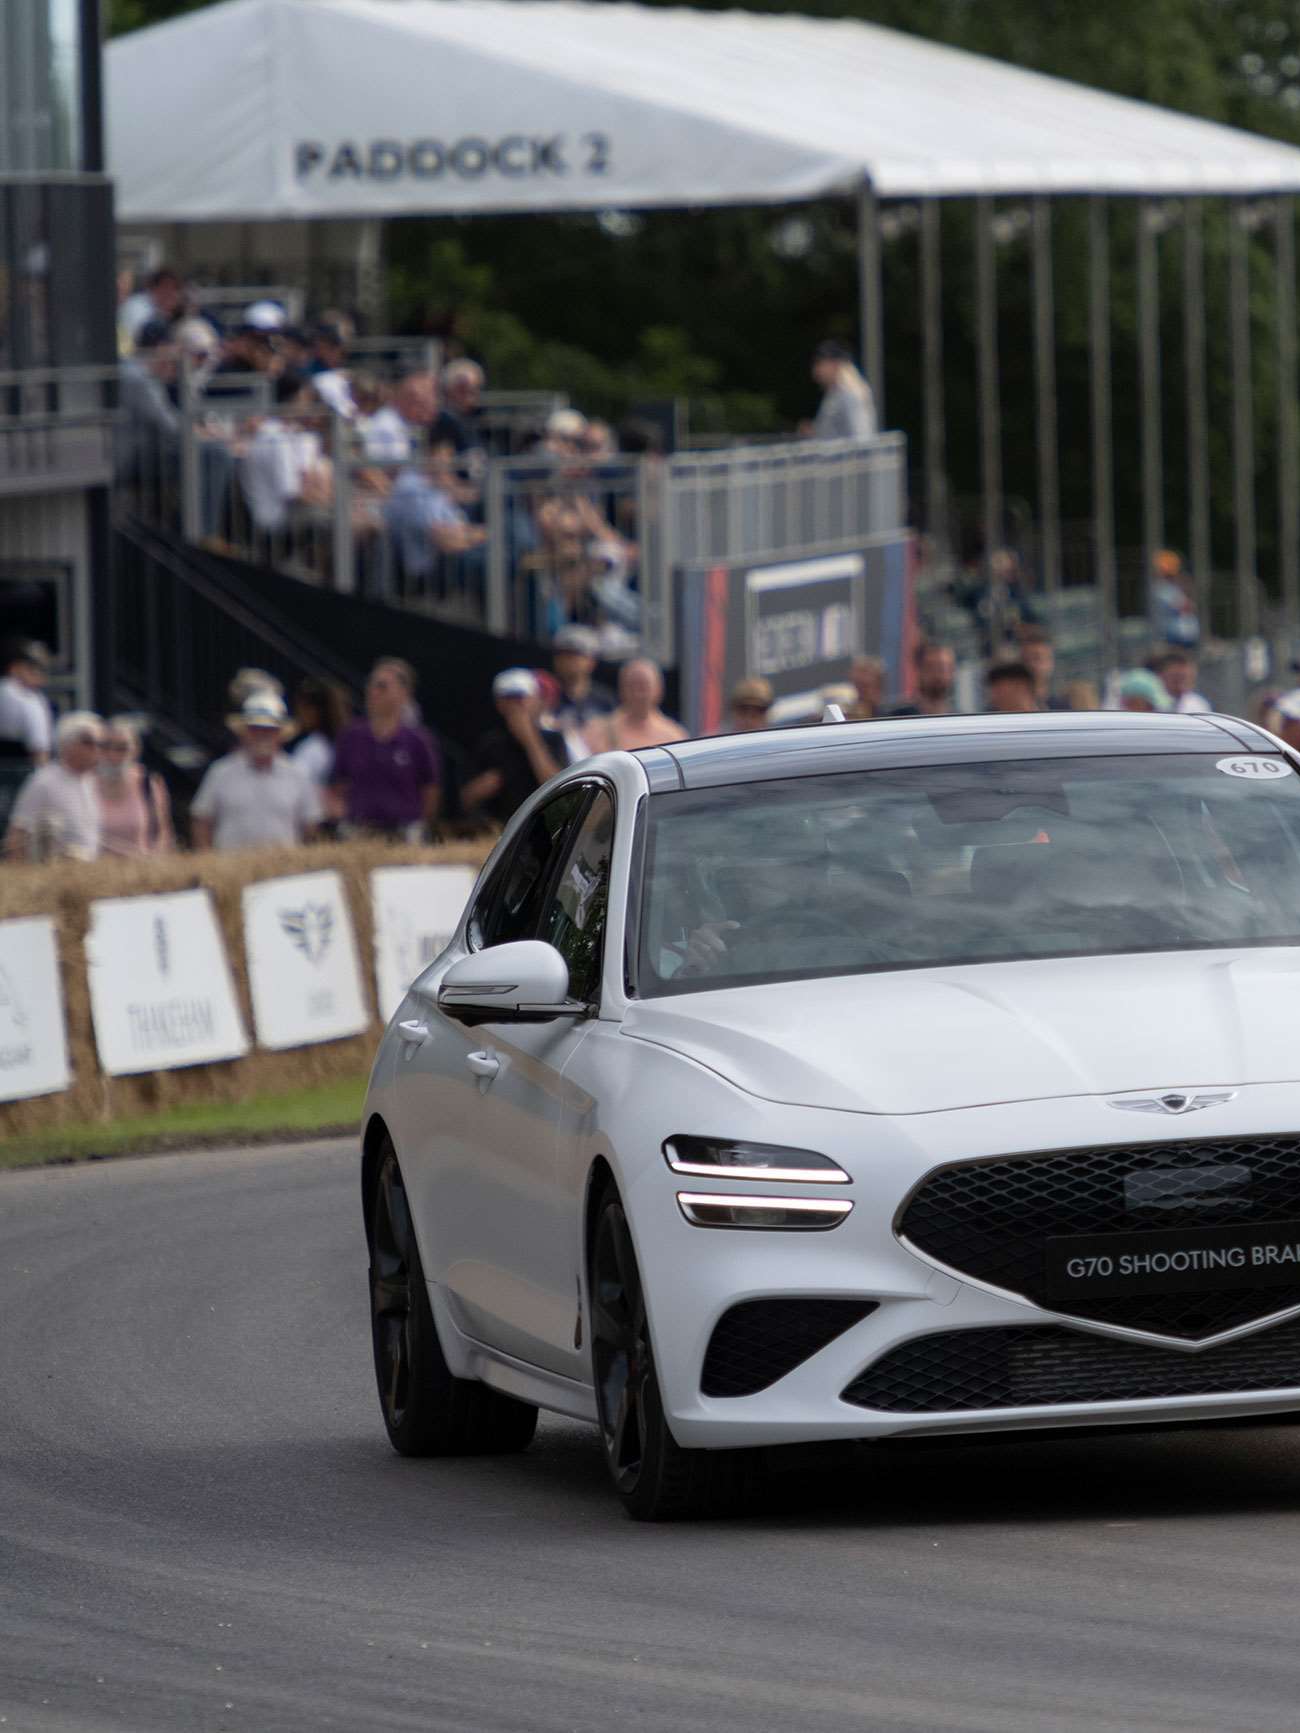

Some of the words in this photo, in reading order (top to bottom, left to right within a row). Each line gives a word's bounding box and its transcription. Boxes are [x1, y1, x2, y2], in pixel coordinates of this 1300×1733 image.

[295, 136, 567, 180] PADDOCK
[582, 131, 610, 174] 2
[1230, 761, 1280, 774] 670
[1066, 1257, 1113, 1278] G70
[1119, 1248, 1245, 1274] SHOOTING
